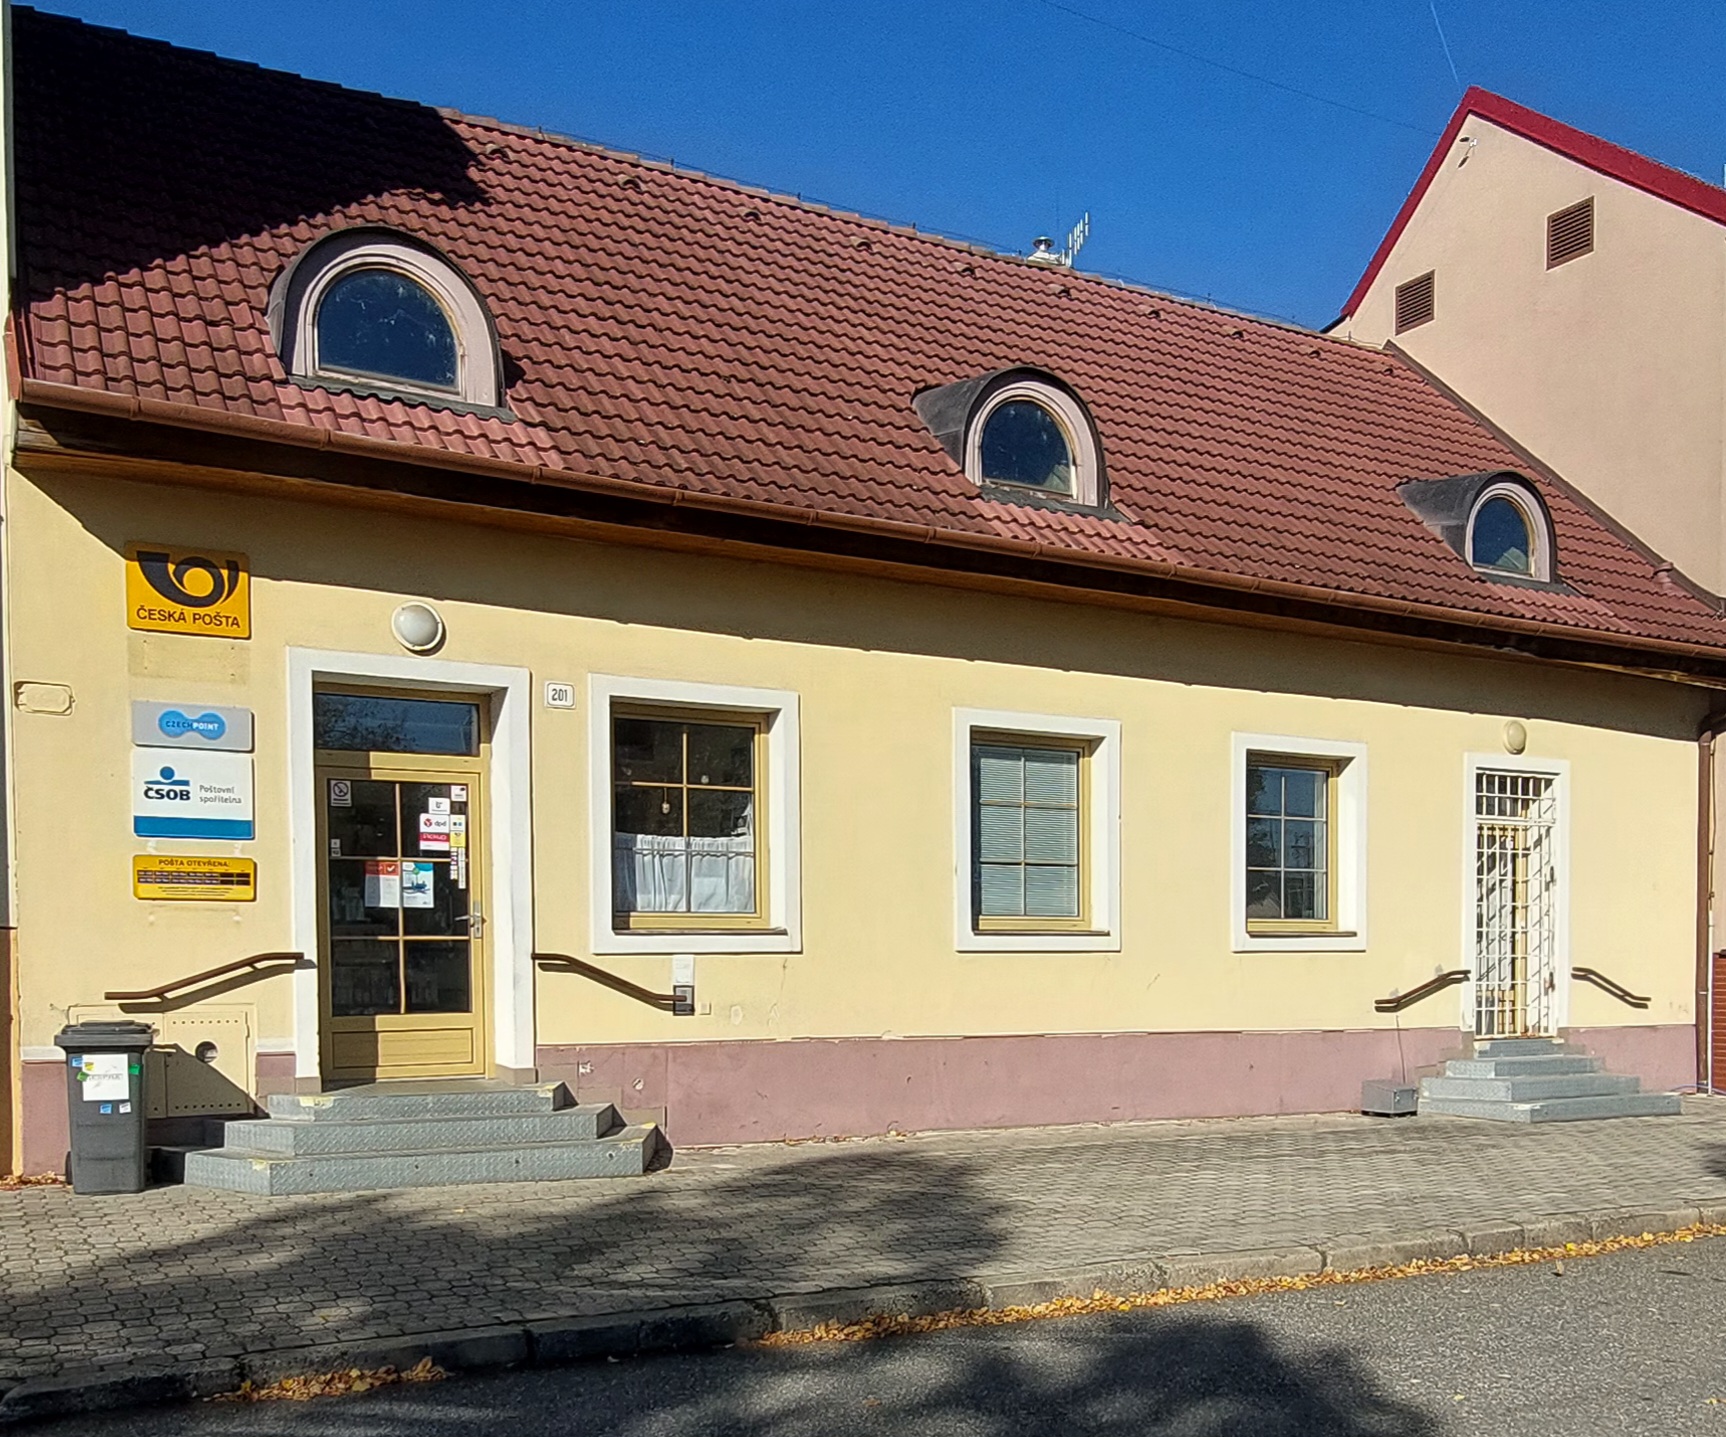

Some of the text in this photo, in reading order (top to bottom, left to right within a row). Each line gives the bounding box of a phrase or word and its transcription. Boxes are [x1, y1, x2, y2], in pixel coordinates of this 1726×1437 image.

[136, 604, 241, 629] ČESKÁ POŠTA
[551, 688, 568, 702] 201
[143, 785, 191, 801] ČSOB
[199, 784, 235, 794] Poštovní
[199, 795, 242, 804] spořitelna
[158, 858, 185, 867] POŠTA
